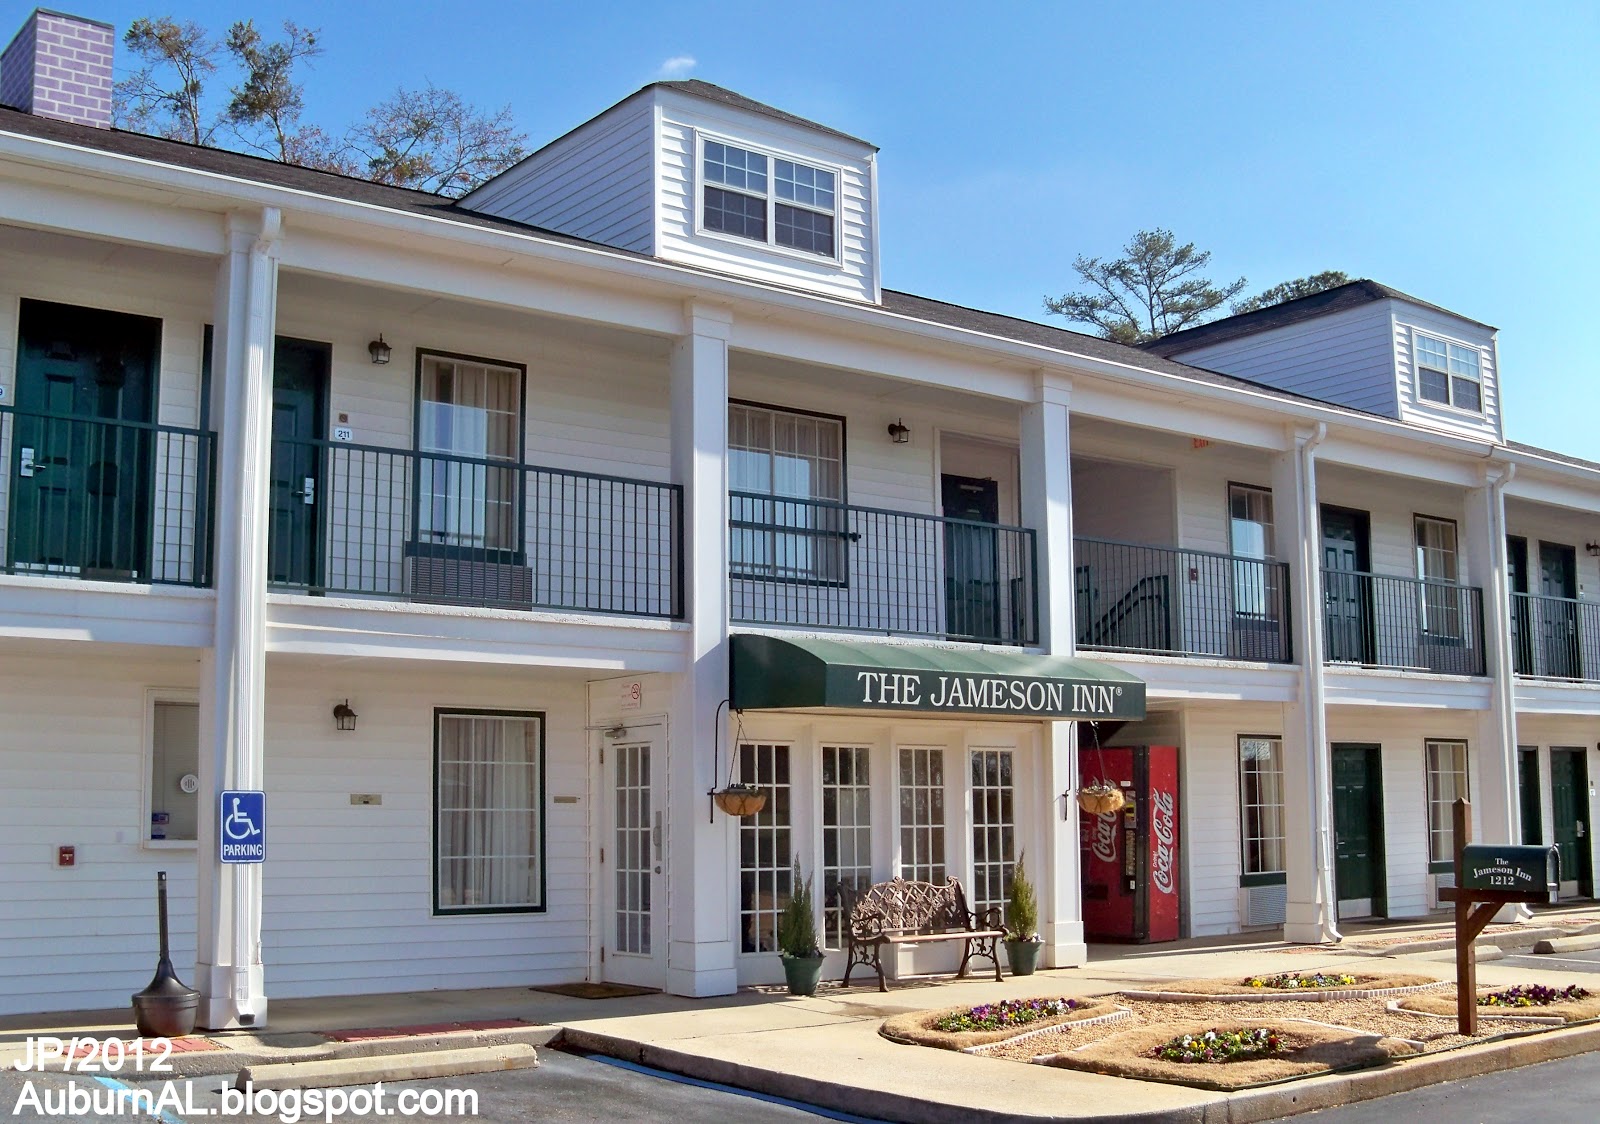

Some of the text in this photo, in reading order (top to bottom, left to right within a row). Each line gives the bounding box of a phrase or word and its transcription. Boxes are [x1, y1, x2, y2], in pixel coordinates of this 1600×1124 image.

[338, 430, 350, 438] 211
[857, 671, 922, 706] THE
[930, 676, 1065, 711] JAMESON
[223, 844, 263, 856] PARKING
[1473, 866, 1532, 881] Jameson Inn
[1490, 876, 1514, 885] 1212
